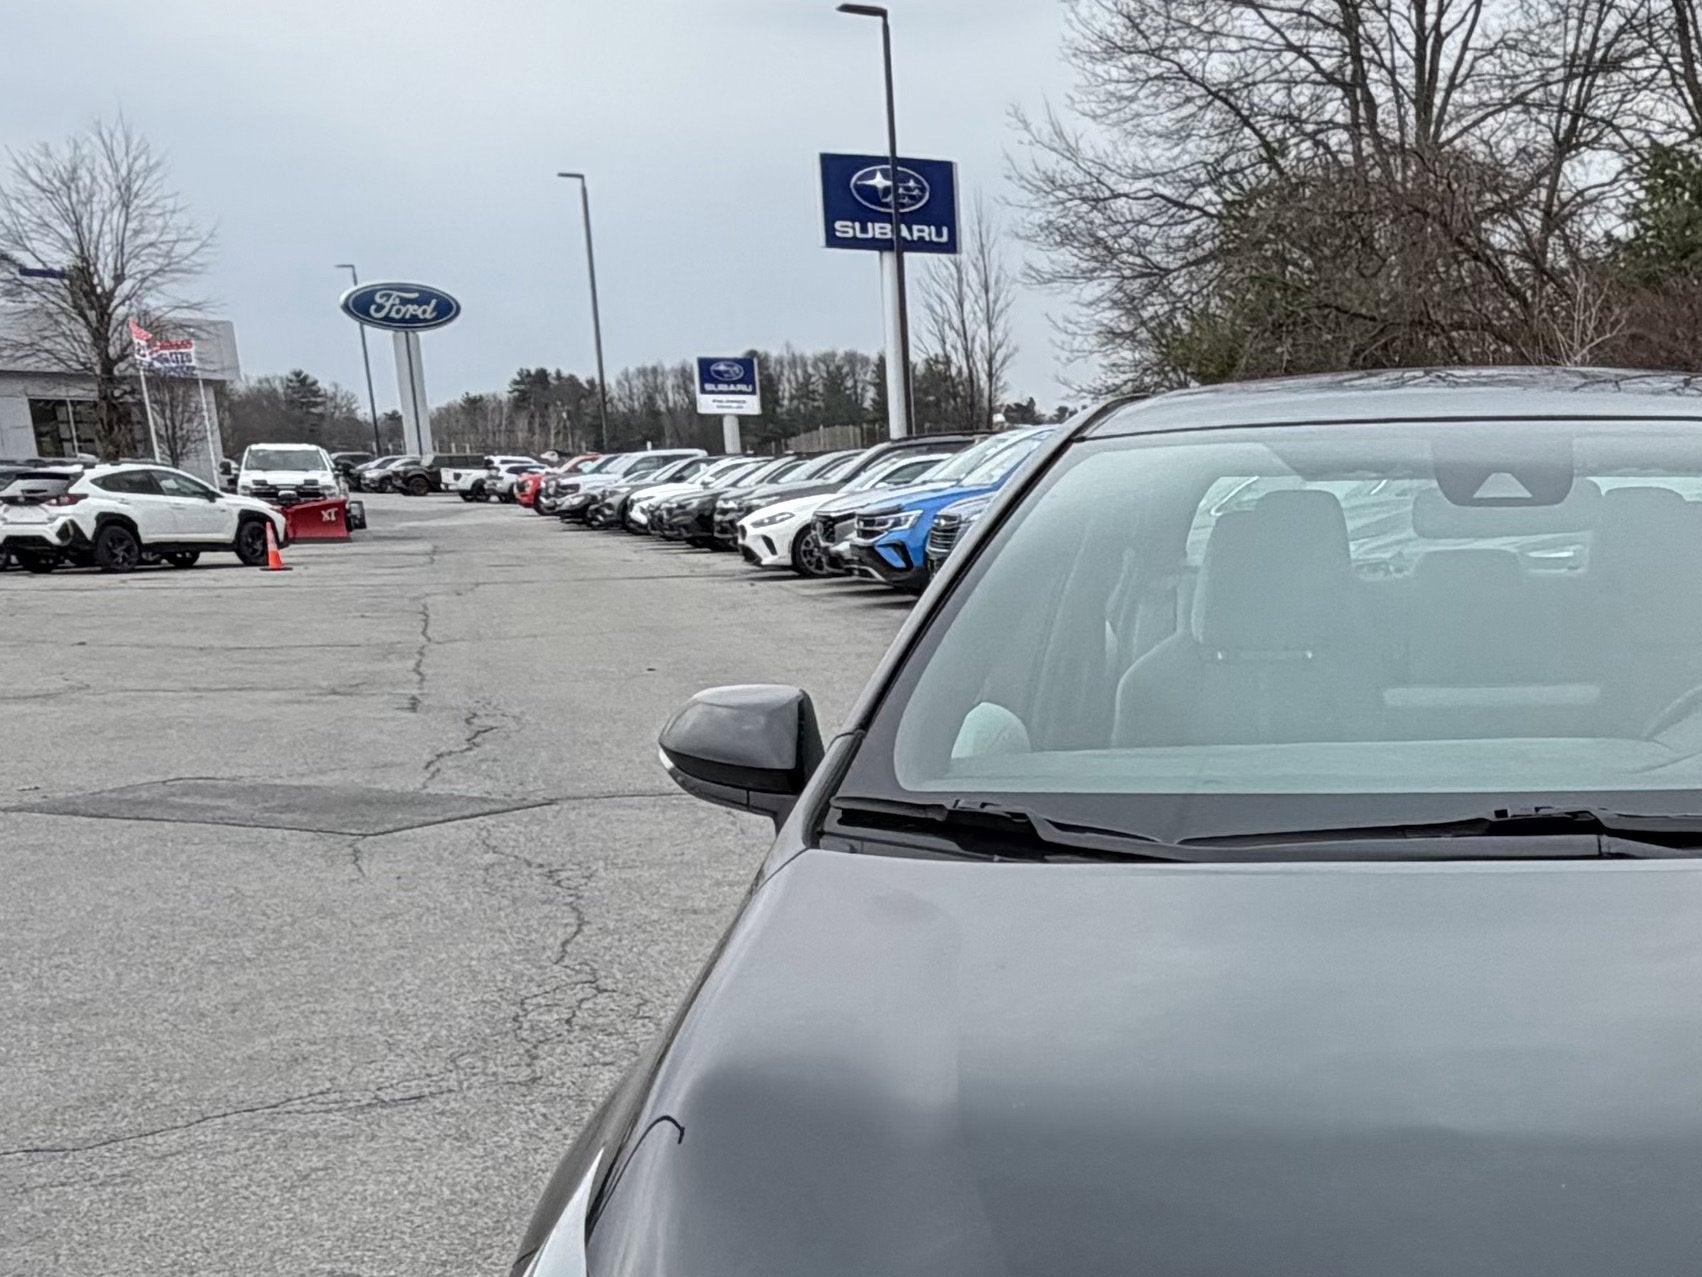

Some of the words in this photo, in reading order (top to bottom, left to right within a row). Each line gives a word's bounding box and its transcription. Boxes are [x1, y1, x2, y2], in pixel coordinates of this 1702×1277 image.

[834, 220, 949, 243] SUBARU
[369, 290, 438, 319] Ford
[321, 507, 339, 522] XT
